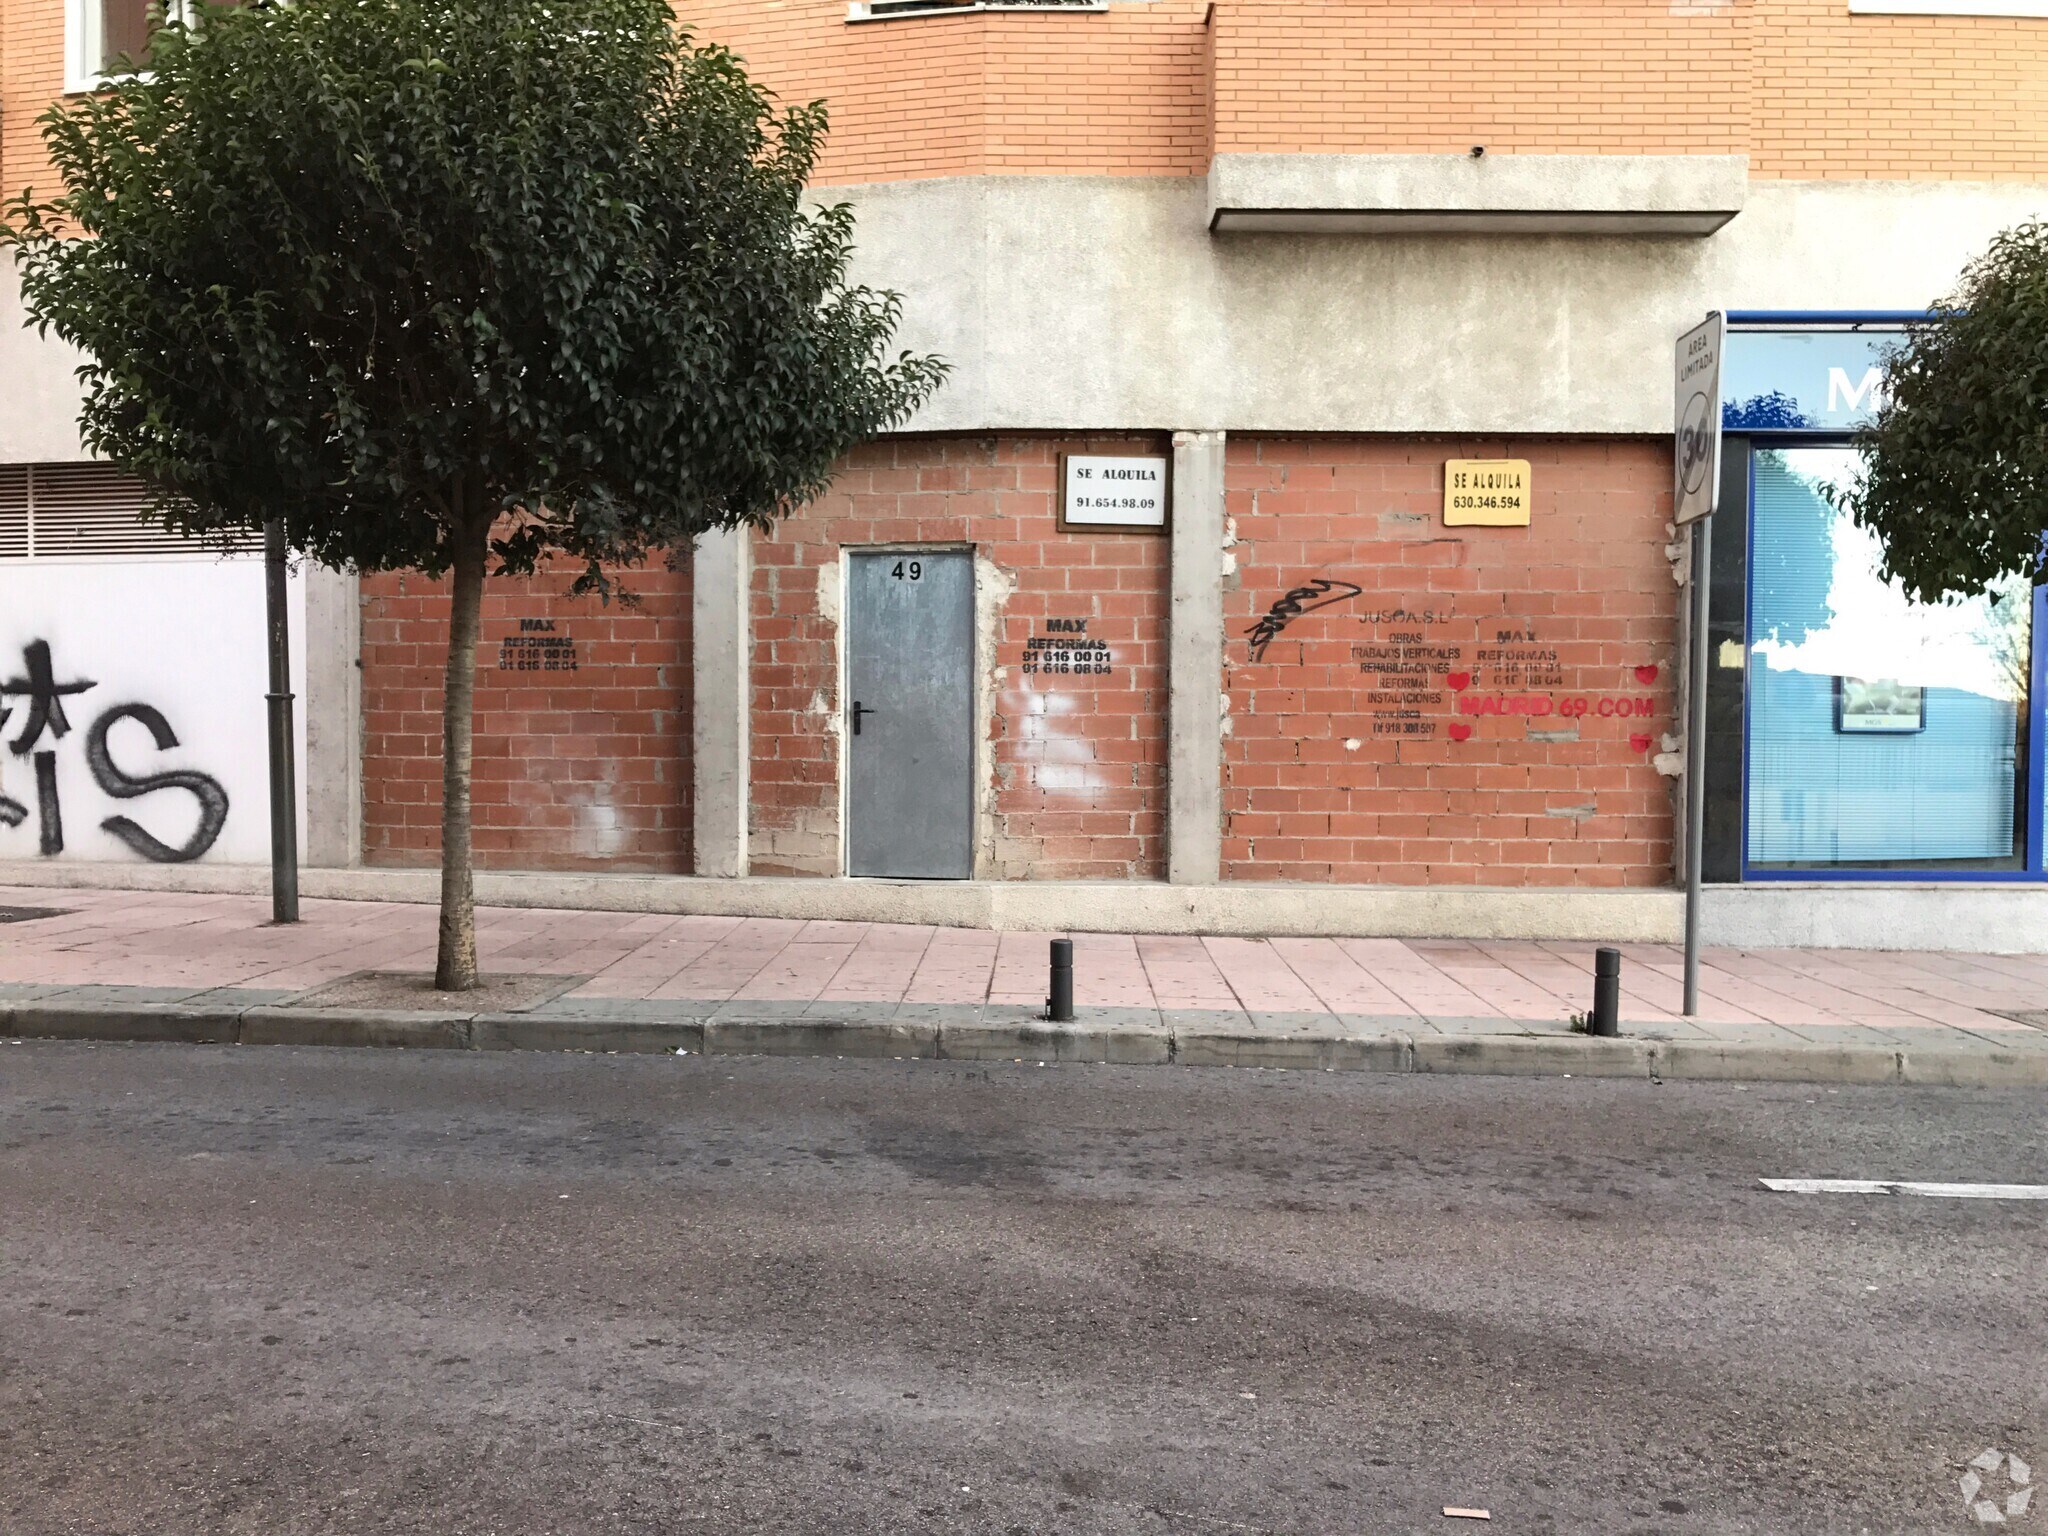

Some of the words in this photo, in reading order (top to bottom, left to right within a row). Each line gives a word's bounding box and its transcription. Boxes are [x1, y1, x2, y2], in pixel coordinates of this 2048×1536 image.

[1688, 334, 1708, 358] ÁREA
[1680, 350, 1714, 383] LIMITADA
[1682, 418, 1708, 470] 30
[1076, 468, 1093, 479] SE
[1102, 469, 1157, 481] ALQUILA
[1454, 473, 1467, 489] SE
[1473, 473, 1522, 489] ALQUILA
[1076, 497, 1155, 509] 91.654.98.09
[1453, 496, 1521, 509] 630.346.594
[891, 561, 922, 581] 49
[520, 619, 556, 631] MAX
[1046, 619, 1088, 633] MAX
[503, 637, 573, 648] REFORMAS
[1389, 632, 1423, 643] OBRAS
[1027, 638, 1108, 650] REFORMAS
[500, 649, 514, 659] 91
[544, 649, 560, 659] 00
[562, 649, 577, 659] 01
[1022, 651, 1039, 662] 91
[1043, 651, 1070, 662] 616
[1074, 651, 1092, 662] 00
[1094, 651, 1112, 662] 01
[1350, 647, 1401, 659] TRABAJOS
[1403, 647, 1461, 660] VERTICALES
[1477, 650, 1557, 661] REFORMAS
[1022, 663, 1039, 674] 91
[1043, 663, 1070, 674] 616
[1074, 663, 1092, 674] 08
[1094, 663, 1112, 674] 04
[1360, 662, 1450, 674] REHABILITACIONES
[1367, 692, 1442, 704] INSTALACIONES
